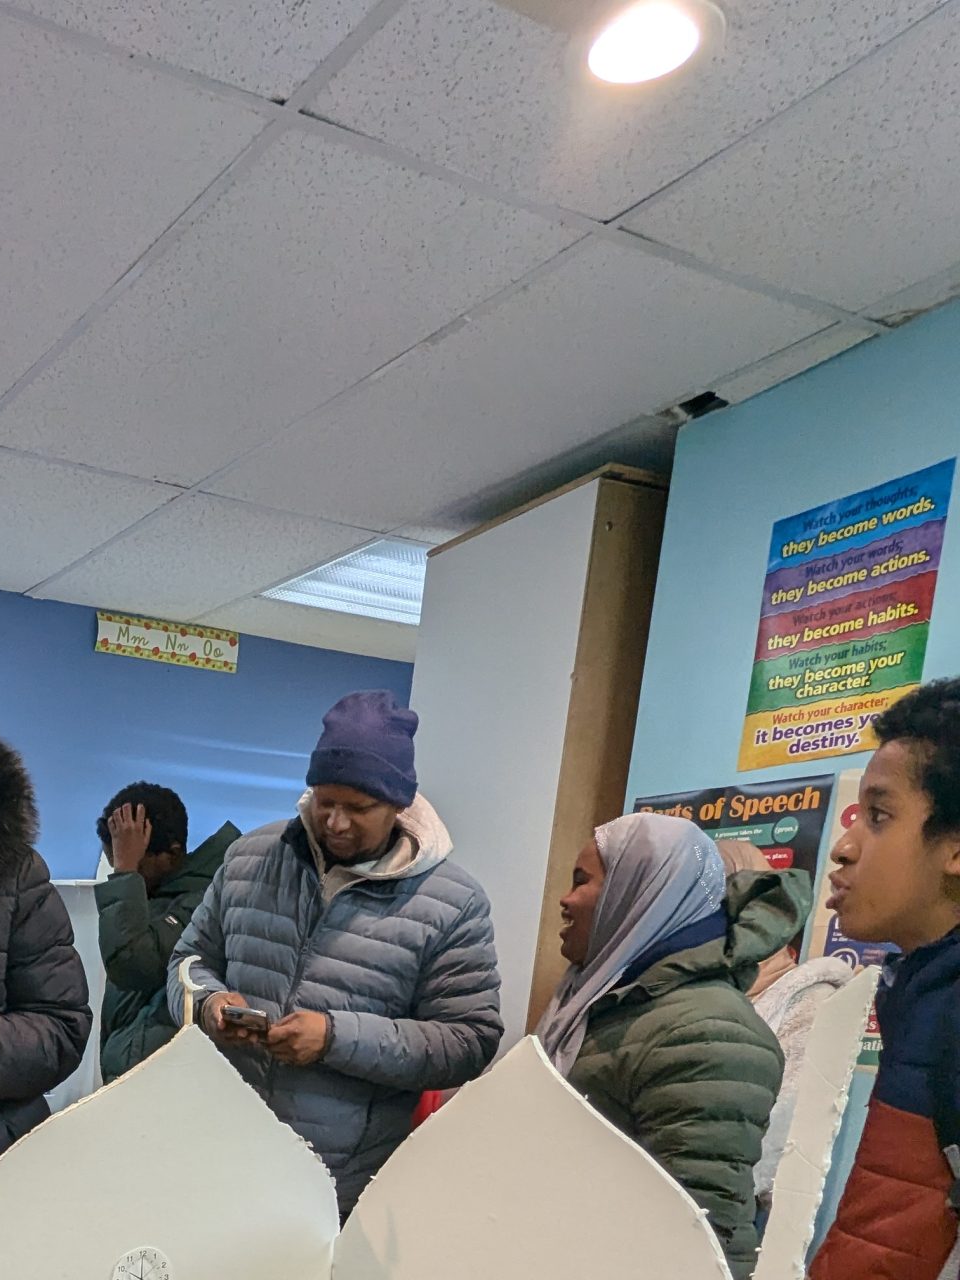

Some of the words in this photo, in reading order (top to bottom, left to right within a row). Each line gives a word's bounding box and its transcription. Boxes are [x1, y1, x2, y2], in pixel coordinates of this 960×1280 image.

[781, 539, 815, 559] they
[817, 516, 878, 547] become
[881, 496, 936, 526] words.
[803, 512, 836, 532] Watch
[837, 504, 863, 522] your
[771, 588, 804, 606] they
[807, 570, 868, 594] become
[871, 549, 931, 577] actions.
[805, 558, 838, 578] Watch
[841, 554, 864, 571] your
[767, 632, 800, 651] they
[803, 618, 864, 641] become
[867, 601, 919, 627] habits.
[792, 609, 826, 626] Watch
[828, 602, 853, 620] your
[116, 625, 149, 647] Mm
[165, 634, 189, 652] Nn
[203, 639, 224, 658] Oo
[768, 673, 801, 691] they
[804, 660, 865, 682] become
[867, 650, 905, 674] your
[789, 653, 822, 670] Watch
[824, 648, 850, 665] your
[795, 675, 871, 699] character.
[772, 709, 805, 725] Watch
[807, 705, 832, 722] your
[834, 697, 890, 714] character;
[754, 729, 769, 745] it
[771, 716, 854, 743] becomes
[789, 731, 860, 755] destiny.
[699, 797, 726, 822] of
[729, 785, 821, 821] Speech
